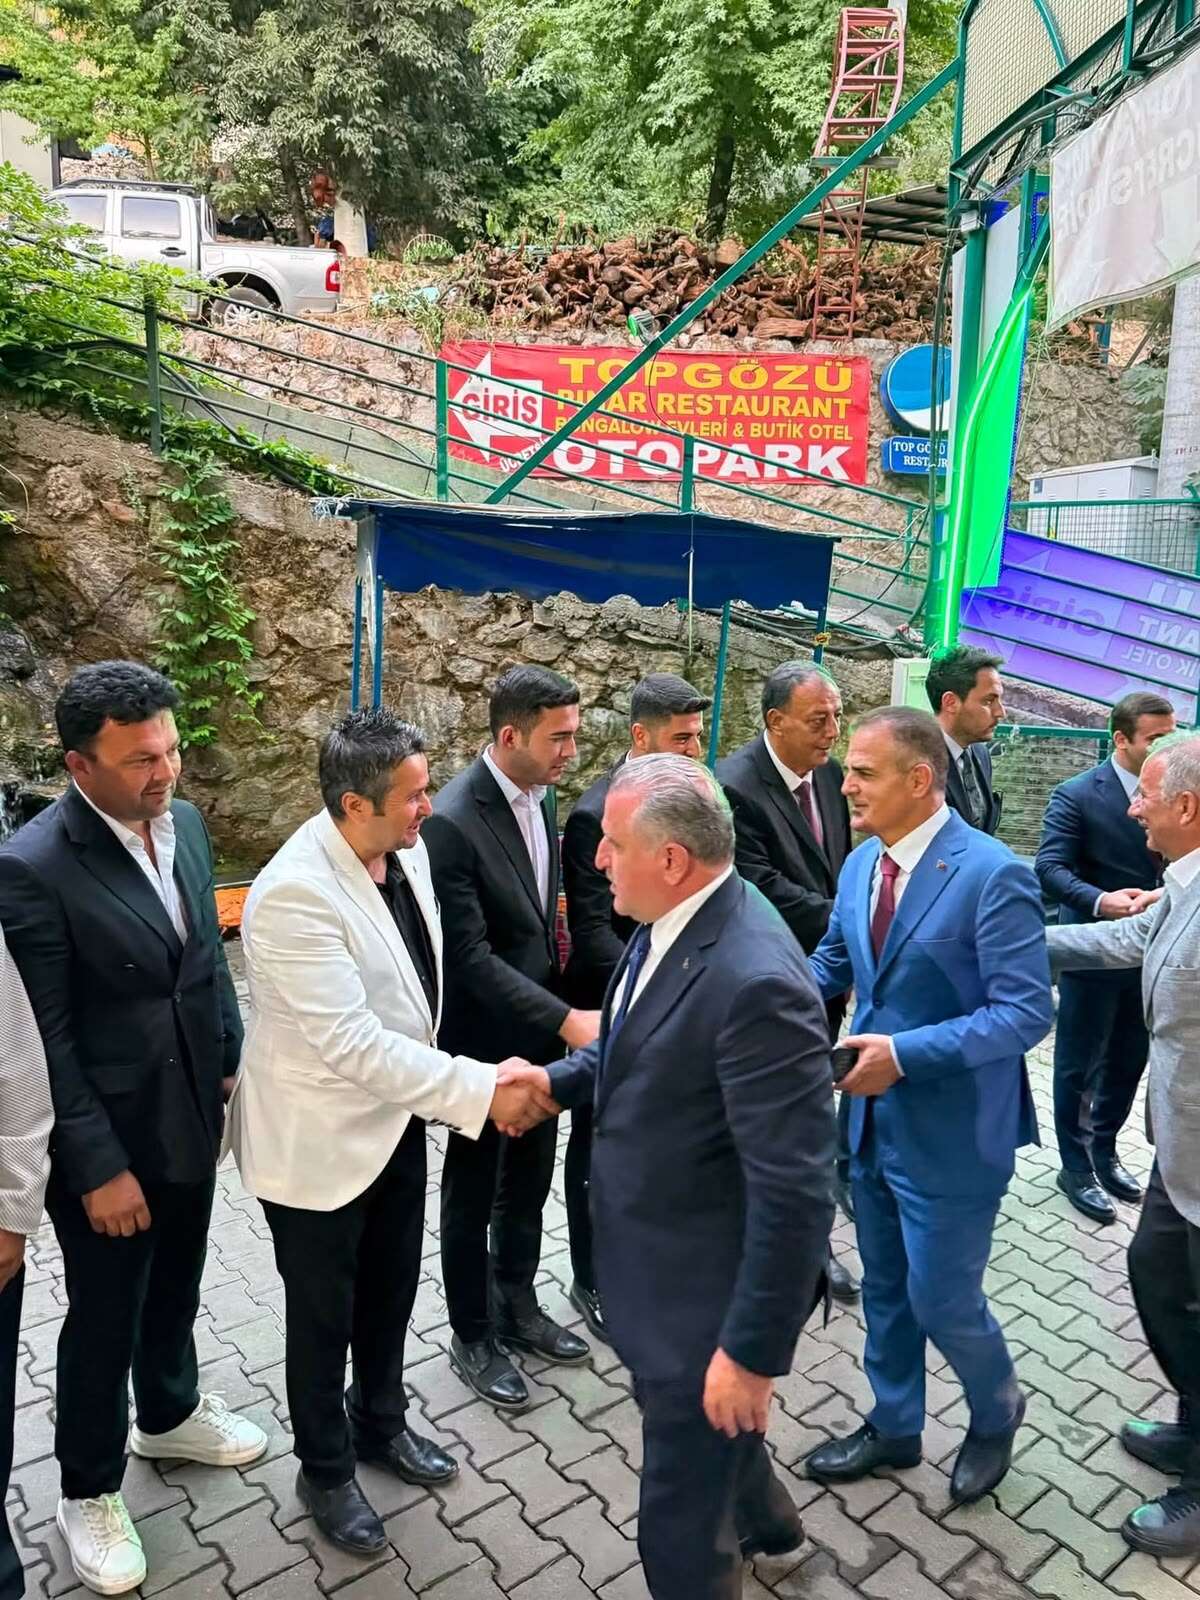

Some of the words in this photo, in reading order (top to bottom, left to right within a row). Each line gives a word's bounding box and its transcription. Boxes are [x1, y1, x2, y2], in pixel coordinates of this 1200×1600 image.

[558, 357, 852, 392] TOPGÖZÜ
[657, 393, 852, 419] RESTAURANT
[555, 416, 660, 435] BNGALOW
[733, 422, 744, 438] &
[750, 419, 804, 439] BUTİK
[809, 424, 853, 441] OTEL
[553, 438, 851, 480] OTOPARK
[893, 441, 915, 453] TOP
[916, 441, 946, 455] GÖÜ
